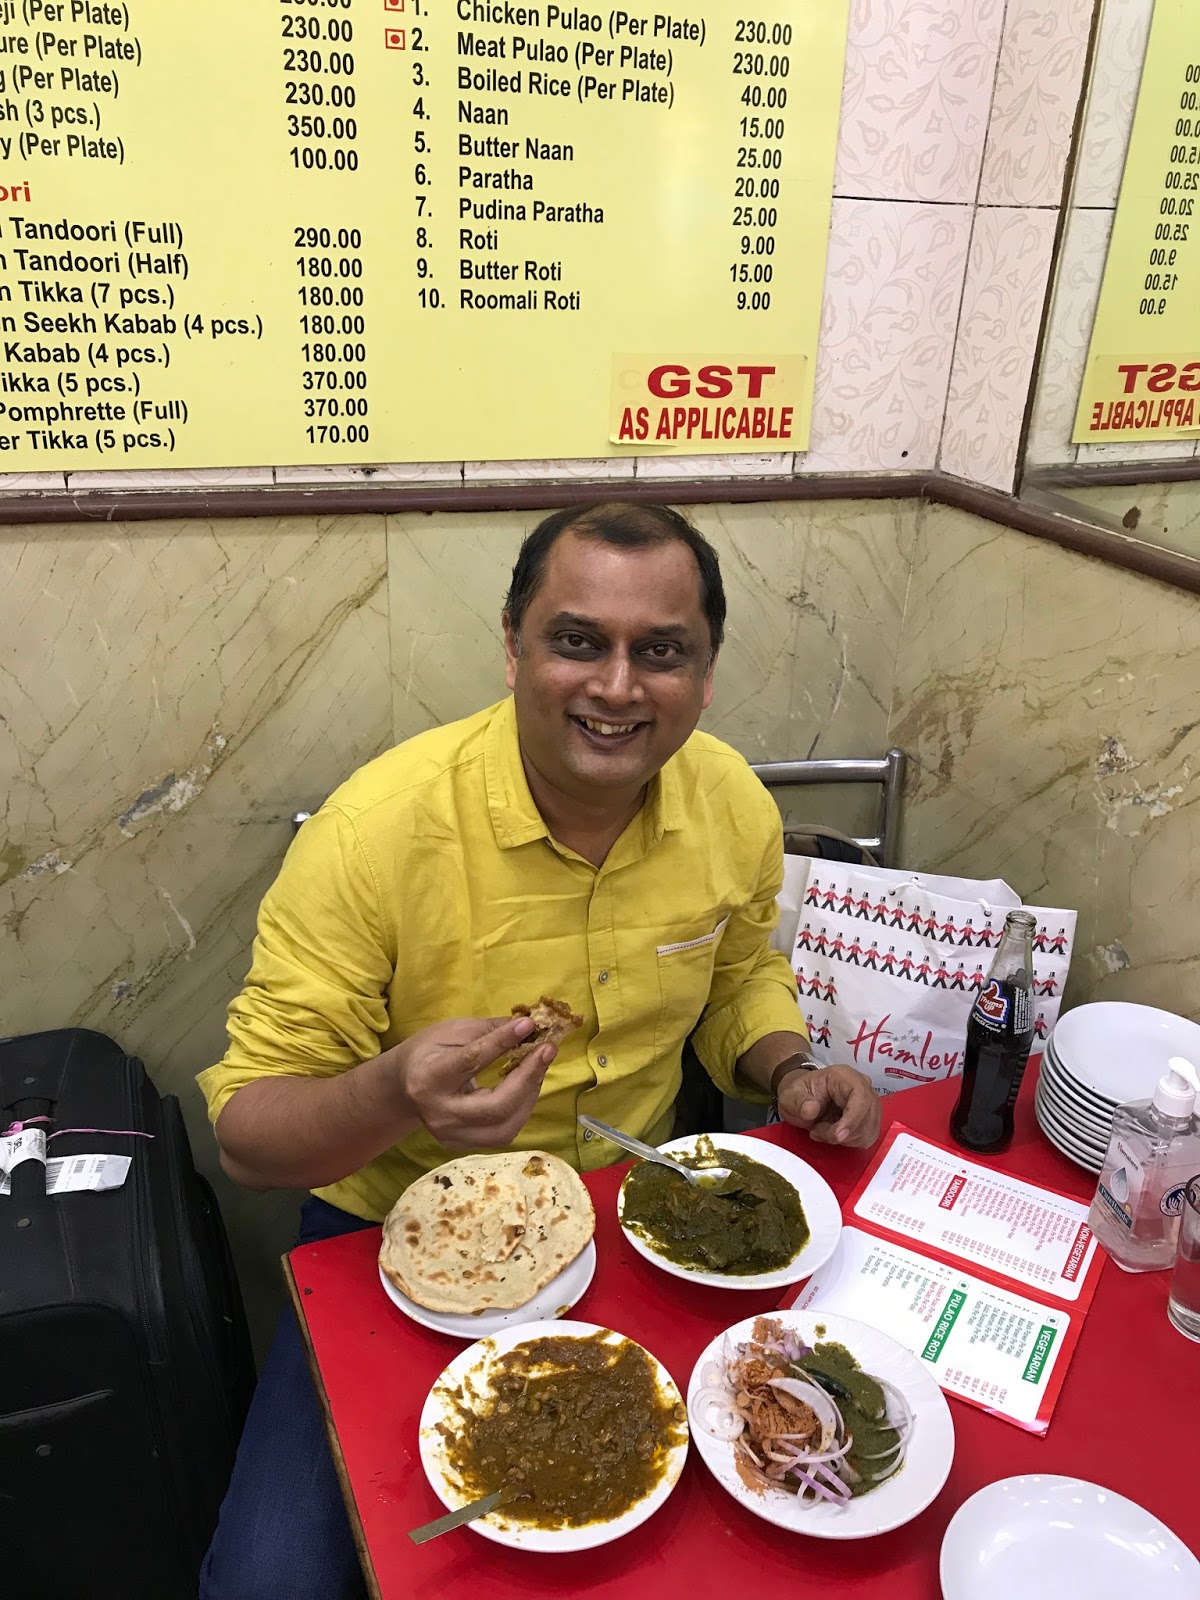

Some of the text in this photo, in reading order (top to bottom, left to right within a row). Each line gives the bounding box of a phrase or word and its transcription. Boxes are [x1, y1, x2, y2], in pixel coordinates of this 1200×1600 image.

[0, 0, 353, 43] ji (Per Plate) 230.00
[415, 0, 792, 47] 1. Chicken Pulao (Per Plate) 230.00
[35, 31, 78, 62] (Per
[83, 34, 142, 67] Plate)
[283, 48, 355, 76] 230.00
[411, 27, 790, 78] 2. Meat Pulao (Per Plate) 230.00
[12, 64, 55, 94] (Per
[60, 67, 119, 99] Plate)
[285, 81, 356, 108] 230.00
[412, 62, 787, 110] 3. Boiled Rice (Per Plate) 40.00
[25, 98, 45, 129] (3
[50, 102, 101, 132] pcs.)
[287, 114, 357, 140] 350.00
[412, 96, 785, 140] 4. Naan 15.00
[0, 131, 359, 172] y (Per Plate) 100.00
[414, 130, 782, 170] 5. Butter Naan 25.00
[0, 181, 32, 203] ori
[414, 163, 780, 199] 6. Paratha 20.00
[415, 195, 778, 228] 7. Pudina Paratha 25.00
[8, 216, 117, 242] Tandoori
[124, 220, 183, 250] (Full)
[294, 226, 362, 249] 290.00
[416, 226, 775, 256] 8. Roti 9.00
[13, 248, 121, 273] Tandoori
[128, 252, 189, 281] (Half)
[296, 256, 363, 278] 180.00
[416, 257, 773, 284] 9. Butter Roti 15.00
[0, 280, 364, 310] n Tikka (7 pcs.) 180.00
[418, 287, 771, 311] 10. Roomali Roti 9.00
[1, 311, 365, 340] n Seekh Kabab (4 pcs.) 180.00
[3, 341, 366, 369] Kabab (4 pcs.) 180.00
[0, 370, 367, 398] ikka (5 pcs.) 370.00
[647, 364, 776, 399] GST
[133, 399, 188, 426] (Full)
[303, 397, 368, 418] 370.00
[618, 406, 794, 441] AS APPLICABLE
[0, 424, 369, 454] er Tikka (5 pcs.) 170.00
[980, 995, 1003, 1009] Thums
[942, 1179, 962, 1208] TANDOORI
[1064, 1225, 1090, 1279] NON-VEGETARIAN
[924, 1293, 962, 1359] PULAO RICE ROTI
[1025, 1330, 1052, 1381] VEGETARIAN
